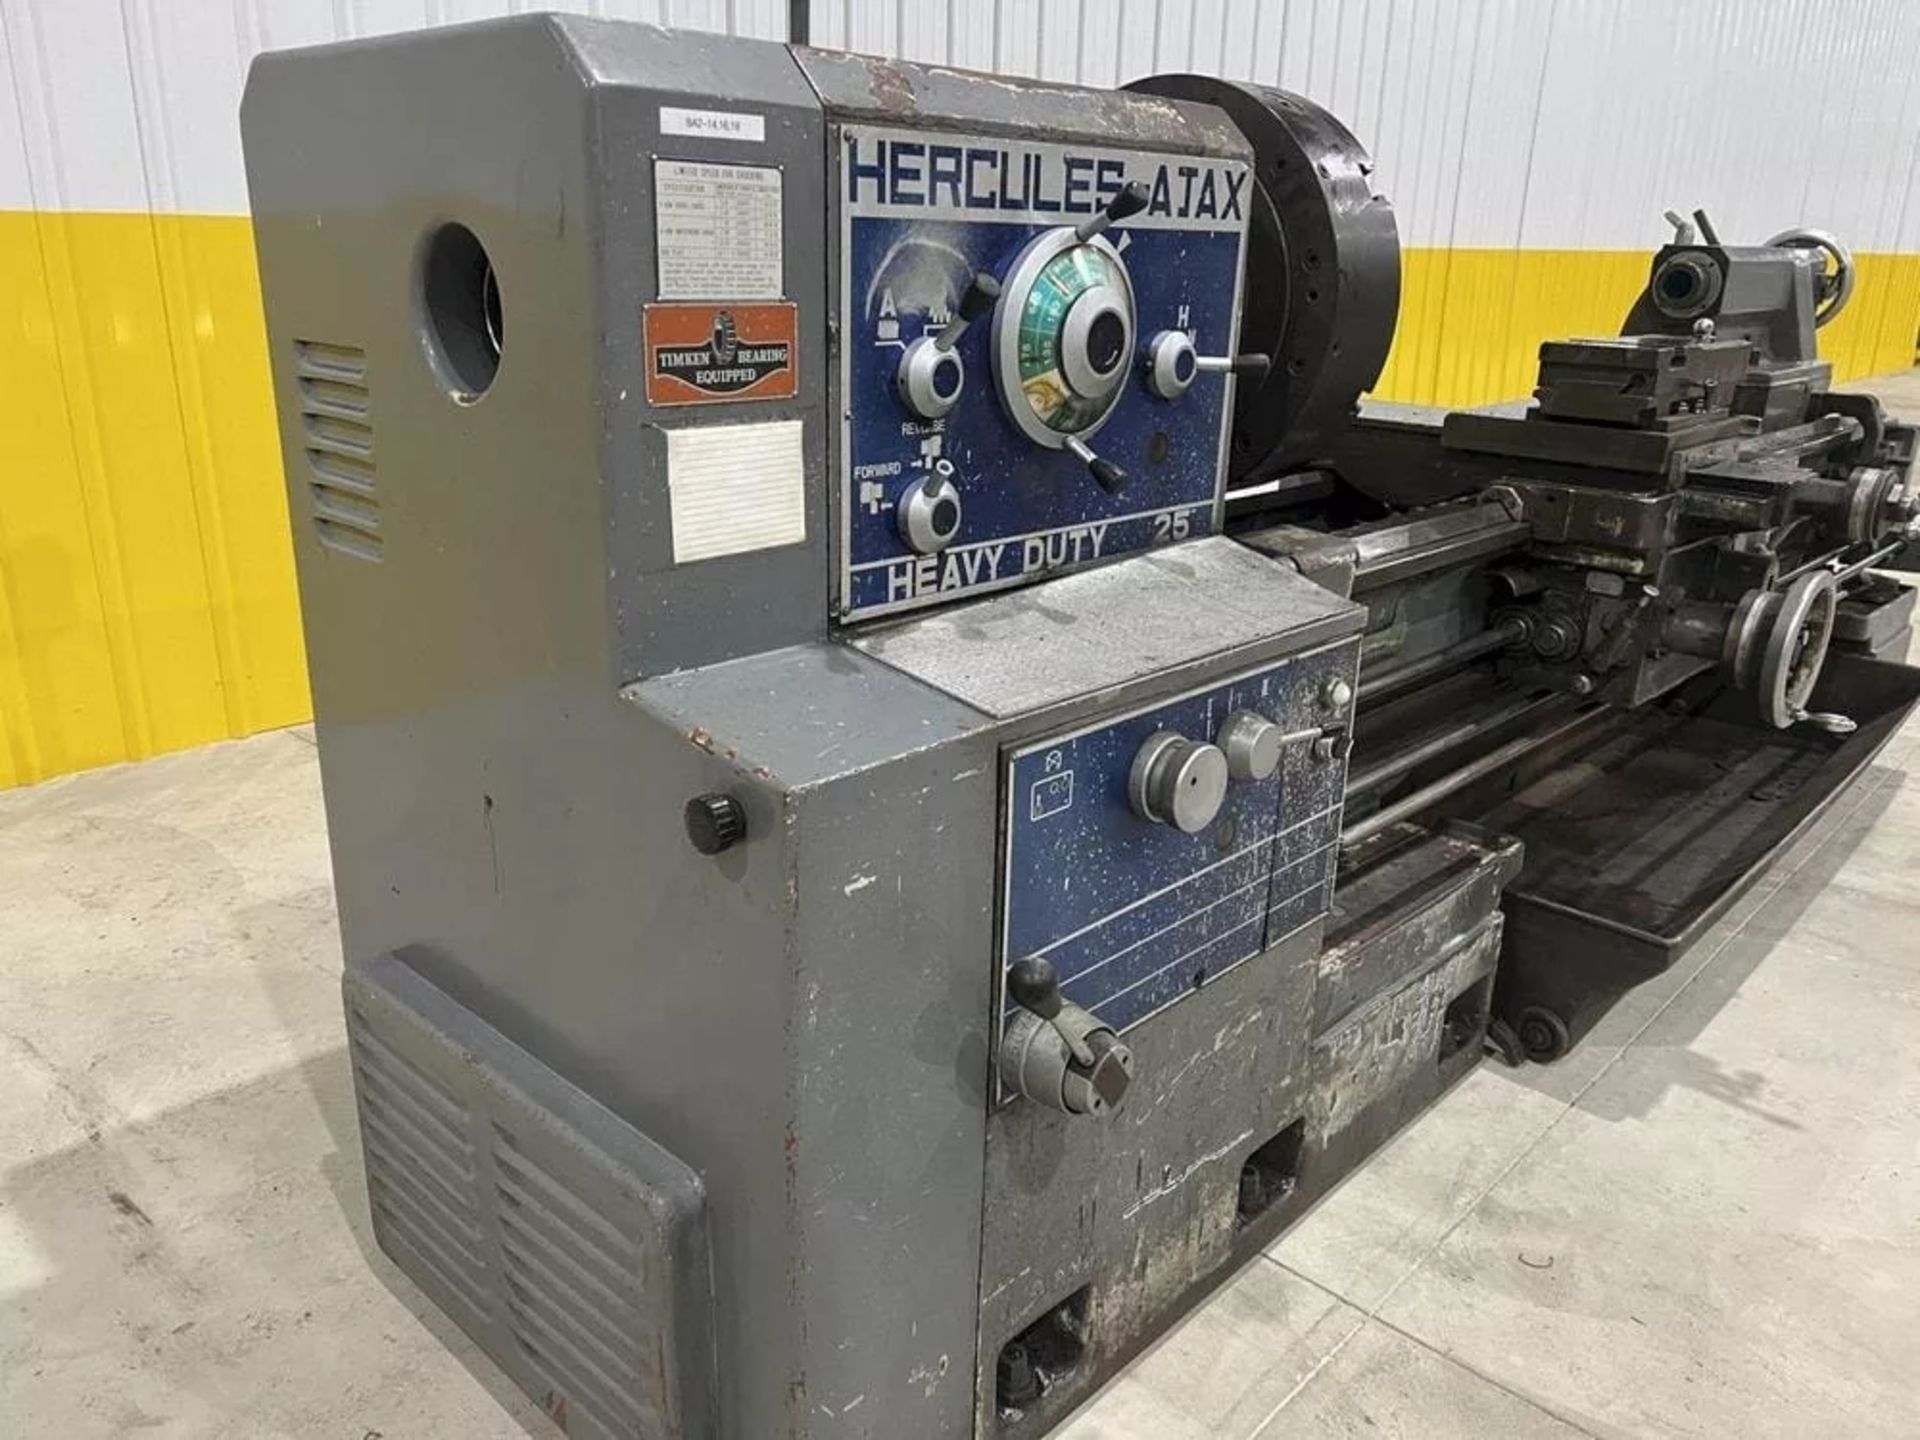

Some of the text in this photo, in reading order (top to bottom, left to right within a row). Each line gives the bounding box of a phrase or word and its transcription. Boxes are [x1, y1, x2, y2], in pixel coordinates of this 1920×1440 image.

[849, 138, 1247, 221] HERCULES AJAX
[1177, 304, 1190, 328] H
[659, 348, 788, 367] TIMKEN BEARING
[696, 369, 757, 385] EQUIPPED
[853, 461, 902, 480] FORWARD
[888, 510, 1191, 602] HEAVY DUTY 25
